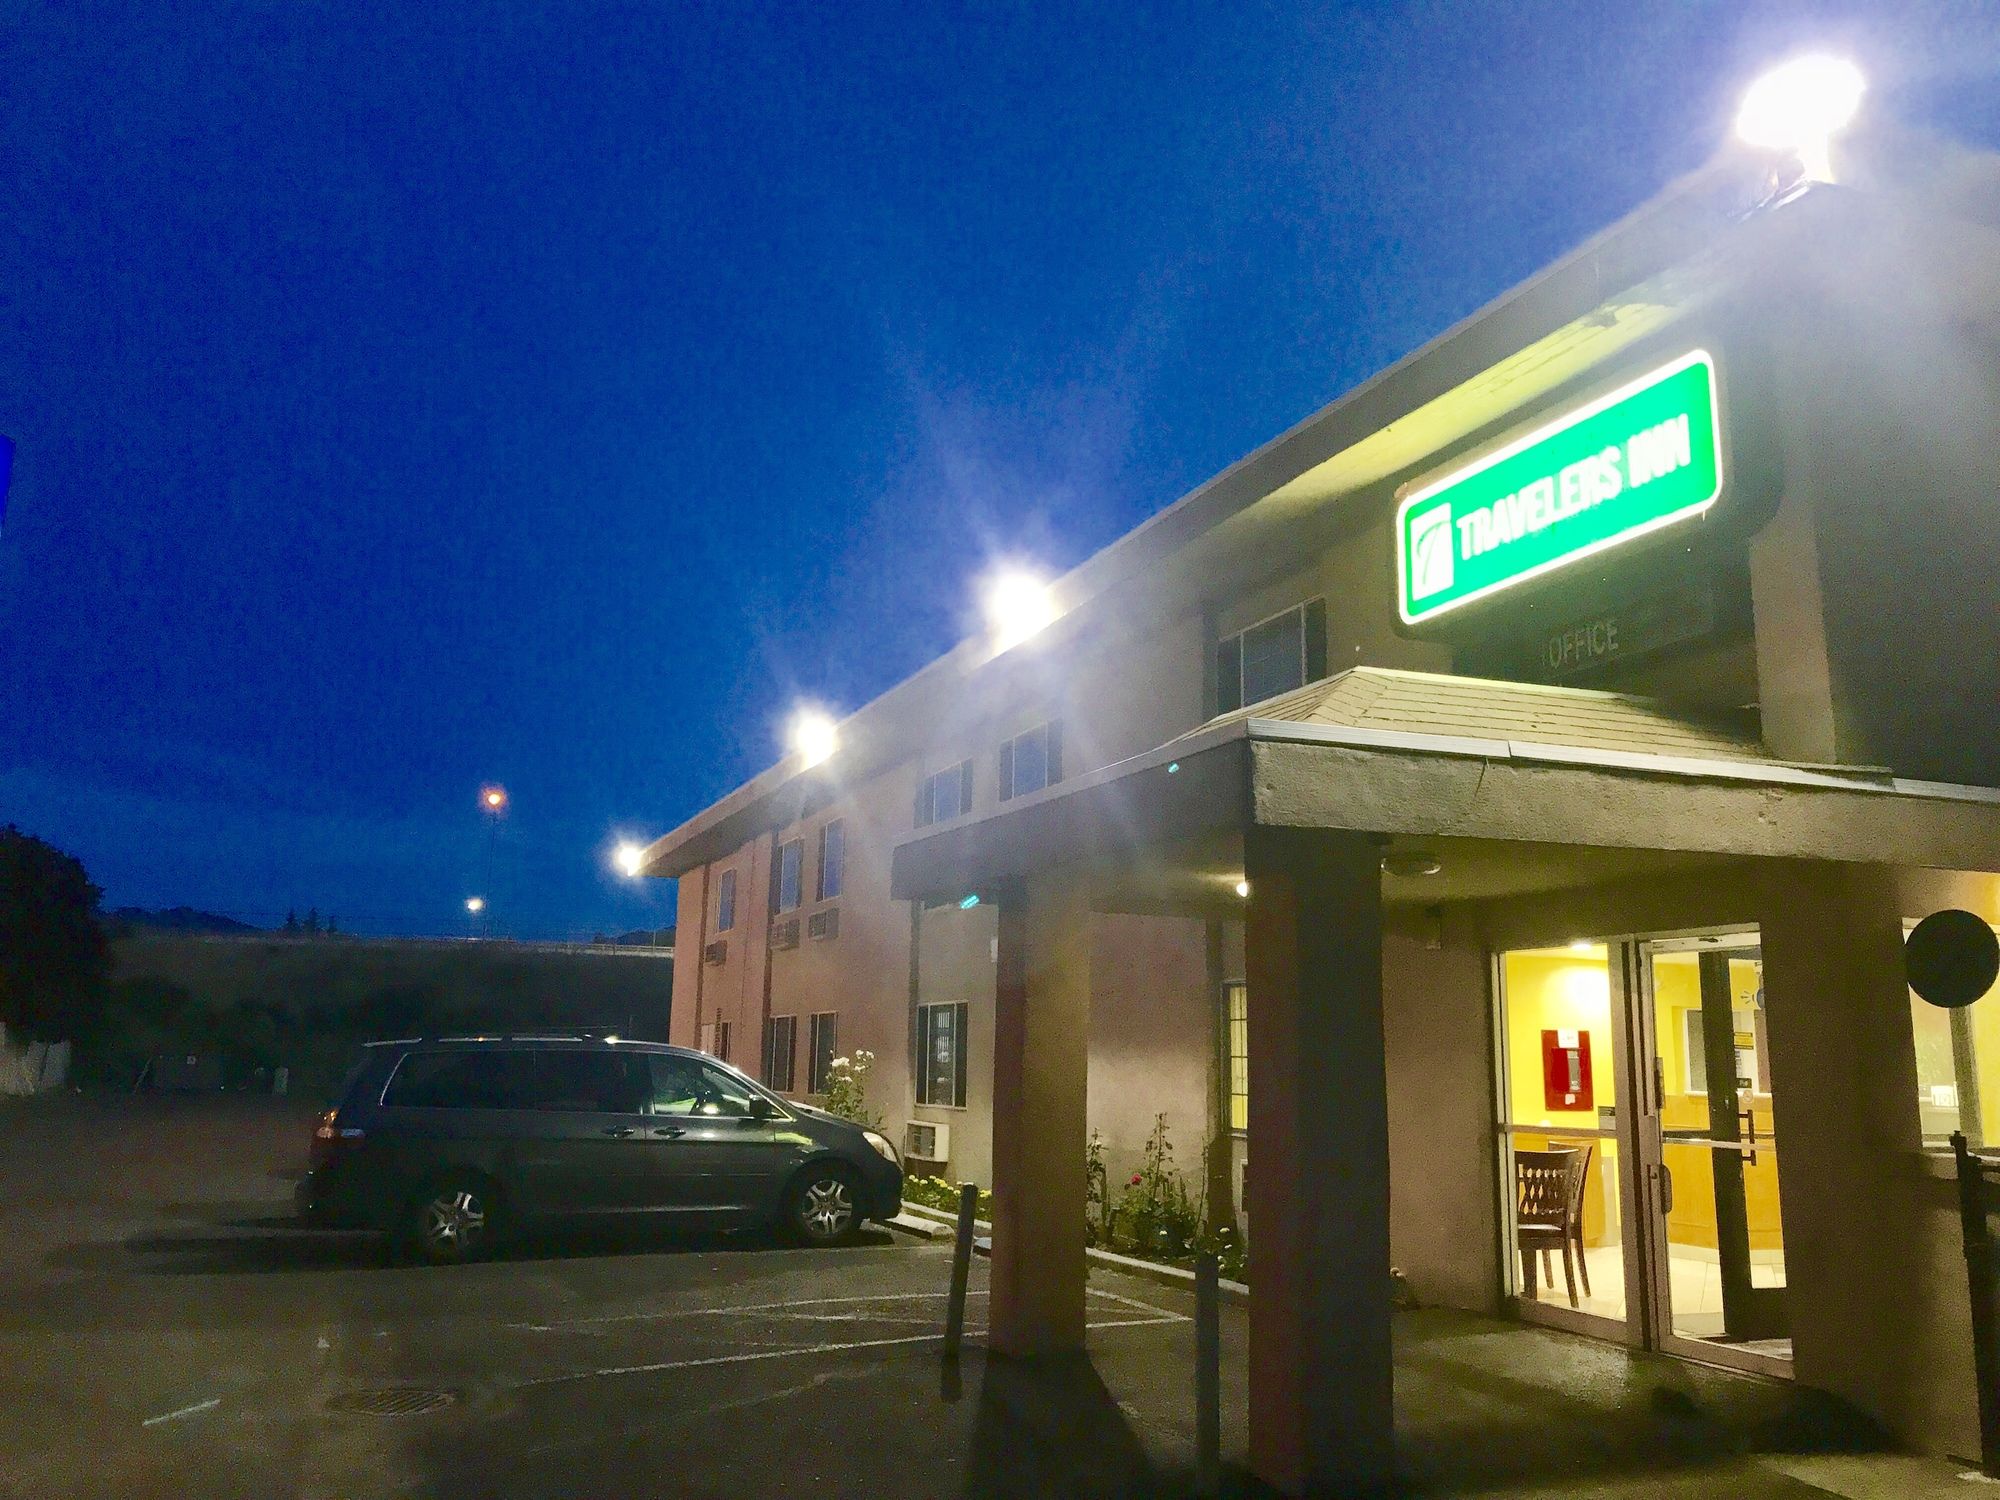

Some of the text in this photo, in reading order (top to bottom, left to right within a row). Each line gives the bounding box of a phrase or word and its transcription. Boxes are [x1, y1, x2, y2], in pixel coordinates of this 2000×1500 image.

[1456, 413, 1691, 560] TRAVELERS INN
[1549, 620, 1619, 669] OFFICE
